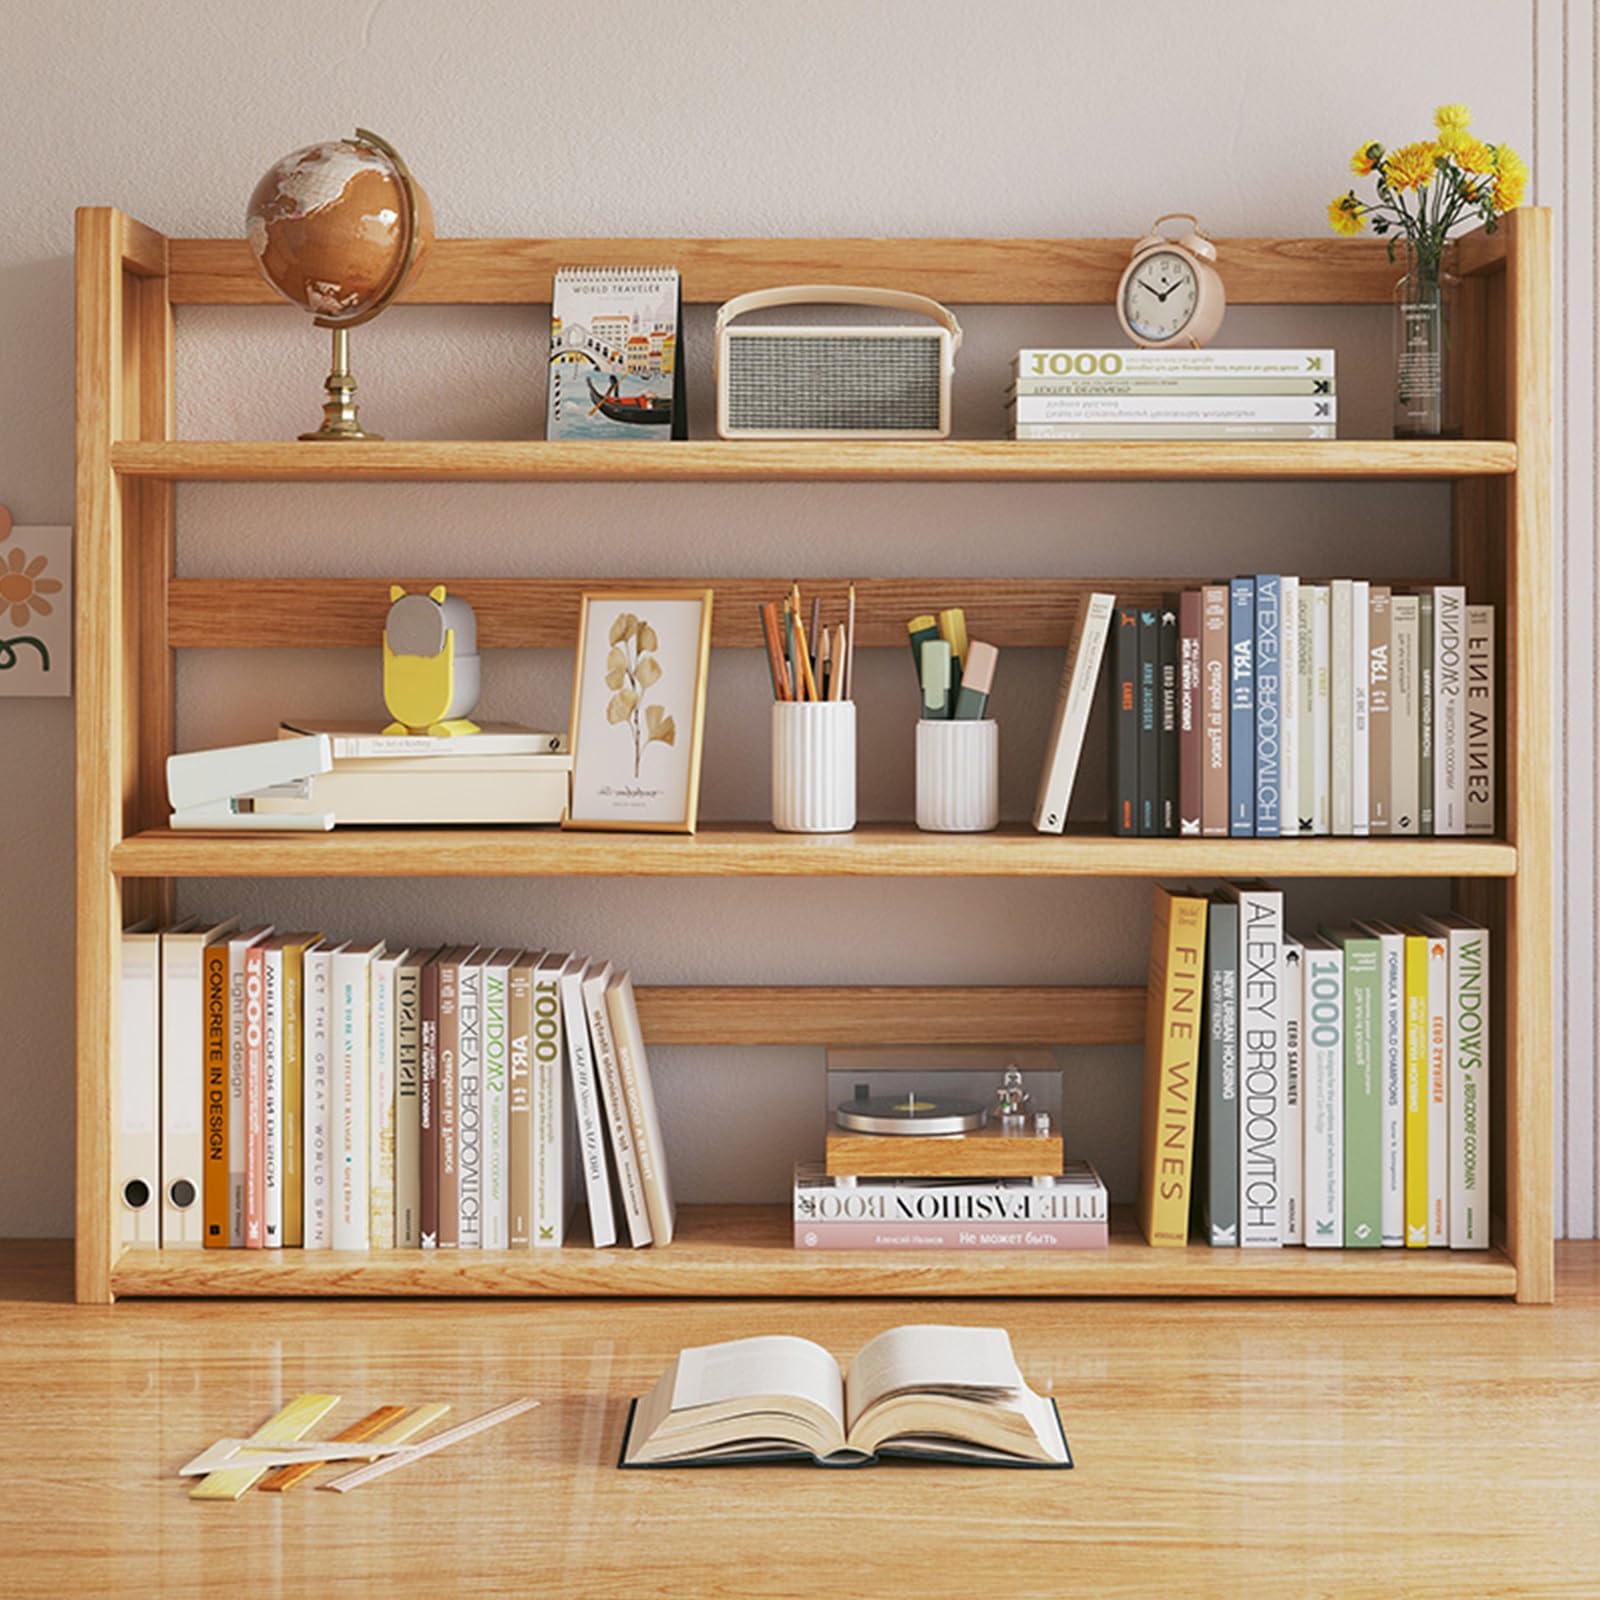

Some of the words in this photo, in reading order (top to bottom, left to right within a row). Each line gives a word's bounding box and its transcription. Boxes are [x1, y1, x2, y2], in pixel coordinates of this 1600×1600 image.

[1142, 663, 1152, 684] ARNE
[1162, 666, 1172, 687] EERO
[1121, 682, 1132, 710] EAMES
[1142, 687, 1152, 730] JACOBSEN
[1162, 689, 1172, 731] SAARINEN
[314, 963, 324, 994] LET
[1246, 901, 1277, 1019] ALEXEY
[1387, 951, 1397, 1000] FORMULA
[230, 972, 243, 1018] Light
[1170, 946, 1197, 1039] FINE
[1212, 970, 1221, 1001] HILARY
[1221, 970, 1233, 998] NEW
[1311, 961, 1340, 1048] 1000
[1457, 940, 1481, 1069] WINDOWS
[209, 959, 223, 1061] CONCRETE
[233, 1020, 243, 1035] in
[314, 1006, 324, 1039] THE
[1212, 1004, 1221, 1040] FRENCH
[1221, 1001, 1233, 1041] URBAN
[1387, 1009, 1397, 1045] WORLD
[1287, 1020, 1297, 1048] EERO
[209, 1067, 223, 1085] IN
[230, 1041, 243, 1098] design
[314, 1053, 324, 1111] GREAT
[1221, 1044, 1233, 1100] HOUSING
[1287, 1052, 1297, 1105] SAARINEN
[1387, 1047, 1397, 1106] CHAMPIONS
[1325, 1090, 1334, 1101] the
[1463, 1083, 1475, 1134] BERGDORF
[209, 1090, 223, 1160] DESIGN
[1160, 1061, 1190, 1200] WINES
[1246, 1030, 1277, 1227] BRODOVITCH
[1325, 1103, 1334, 1131] gardens
[314, 1124, 324, 1187] WORLD
[1325, 1134, 1334, 1146] and
[1325, 1148, 1334, 1169] where
[1463, 1136, 1475, 1190] GOODMAN
[314, 1200, 324, 1241] SPIN
[896, 1195, 1030, 1219] FASHION
[1041, 1195, 1105, 1219] THE
[960, 1232, 975, 1244] Не
